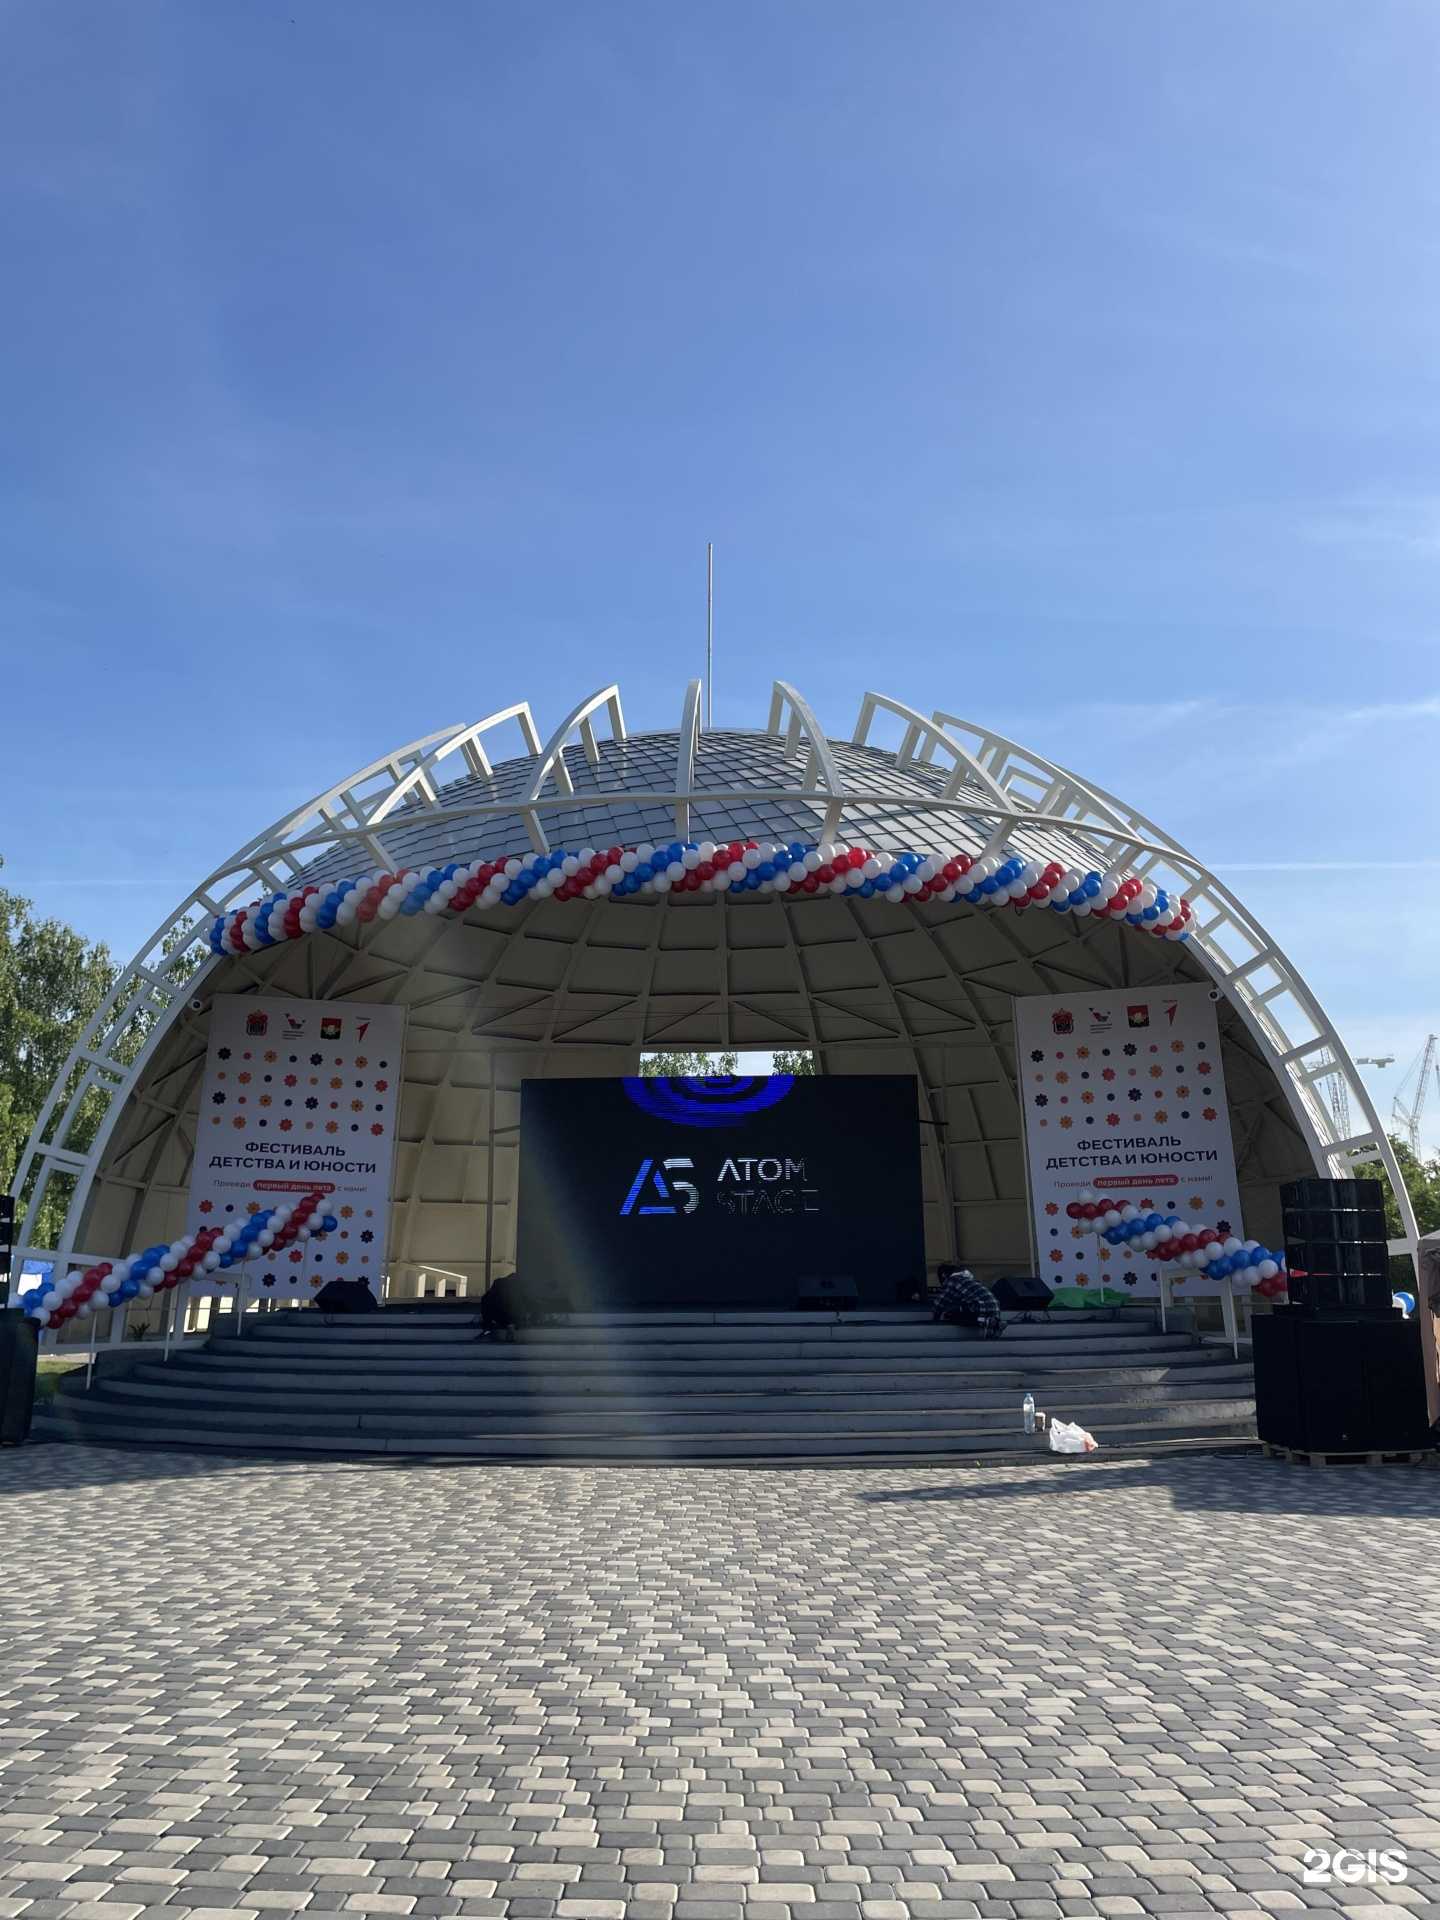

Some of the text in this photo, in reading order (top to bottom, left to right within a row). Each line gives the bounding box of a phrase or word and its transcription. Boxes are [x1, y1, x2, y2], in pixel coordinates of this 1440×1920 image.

[245, 1142, 345, 1156] ФЕСТИВАЛЬ
[1077, 1136, 1181, 1151] ФЕСТИВАЛЬ
[209, 1156, 376, 1173] ДЕТСТВА И ЮНОСТИ
[1046, 1150, 1218, 1170] ДЕТСТВА И ЮНОСТИ
[717, 1157, 807, 1182] ATOM
